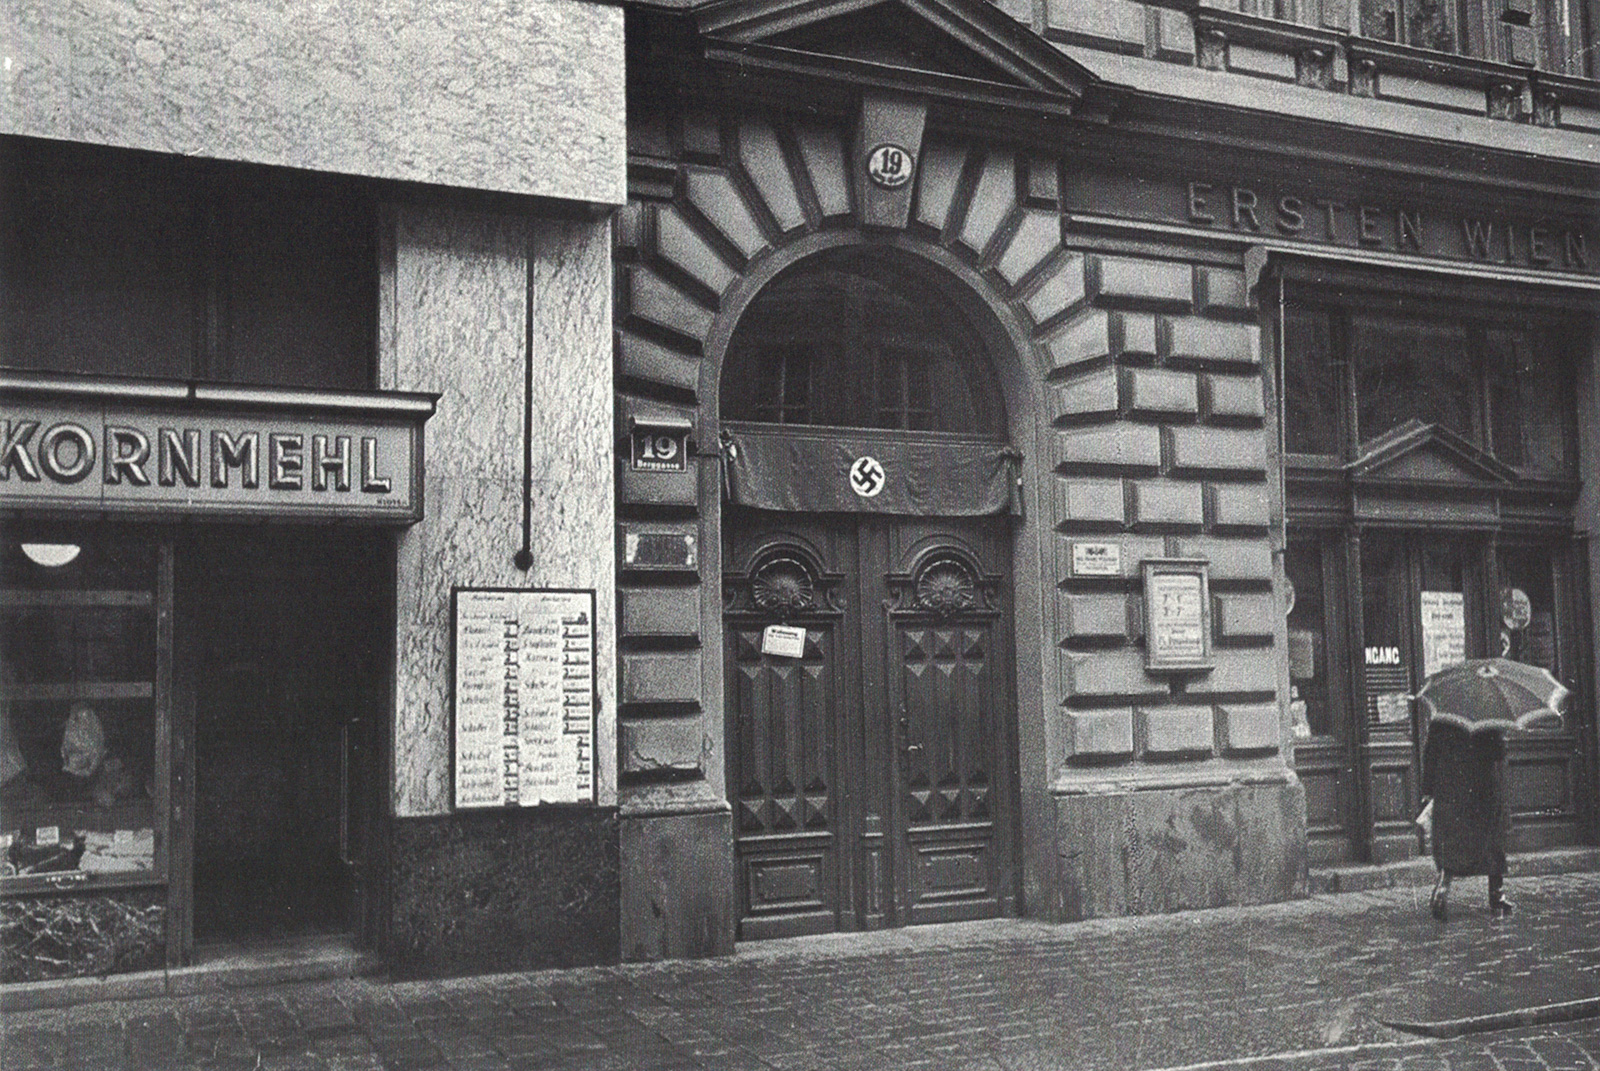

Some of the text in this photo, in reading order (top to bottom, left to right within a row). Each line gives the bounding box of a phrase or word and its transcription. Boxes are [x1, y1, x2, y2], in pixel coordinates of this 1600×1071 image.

[880, 149, 903, 175] 19
[1187, 181, 1588, 268] ERSTEN WIEN
[0, 420, 391, 493] KORNMEHL
[641, 435, 678, 459] 19
